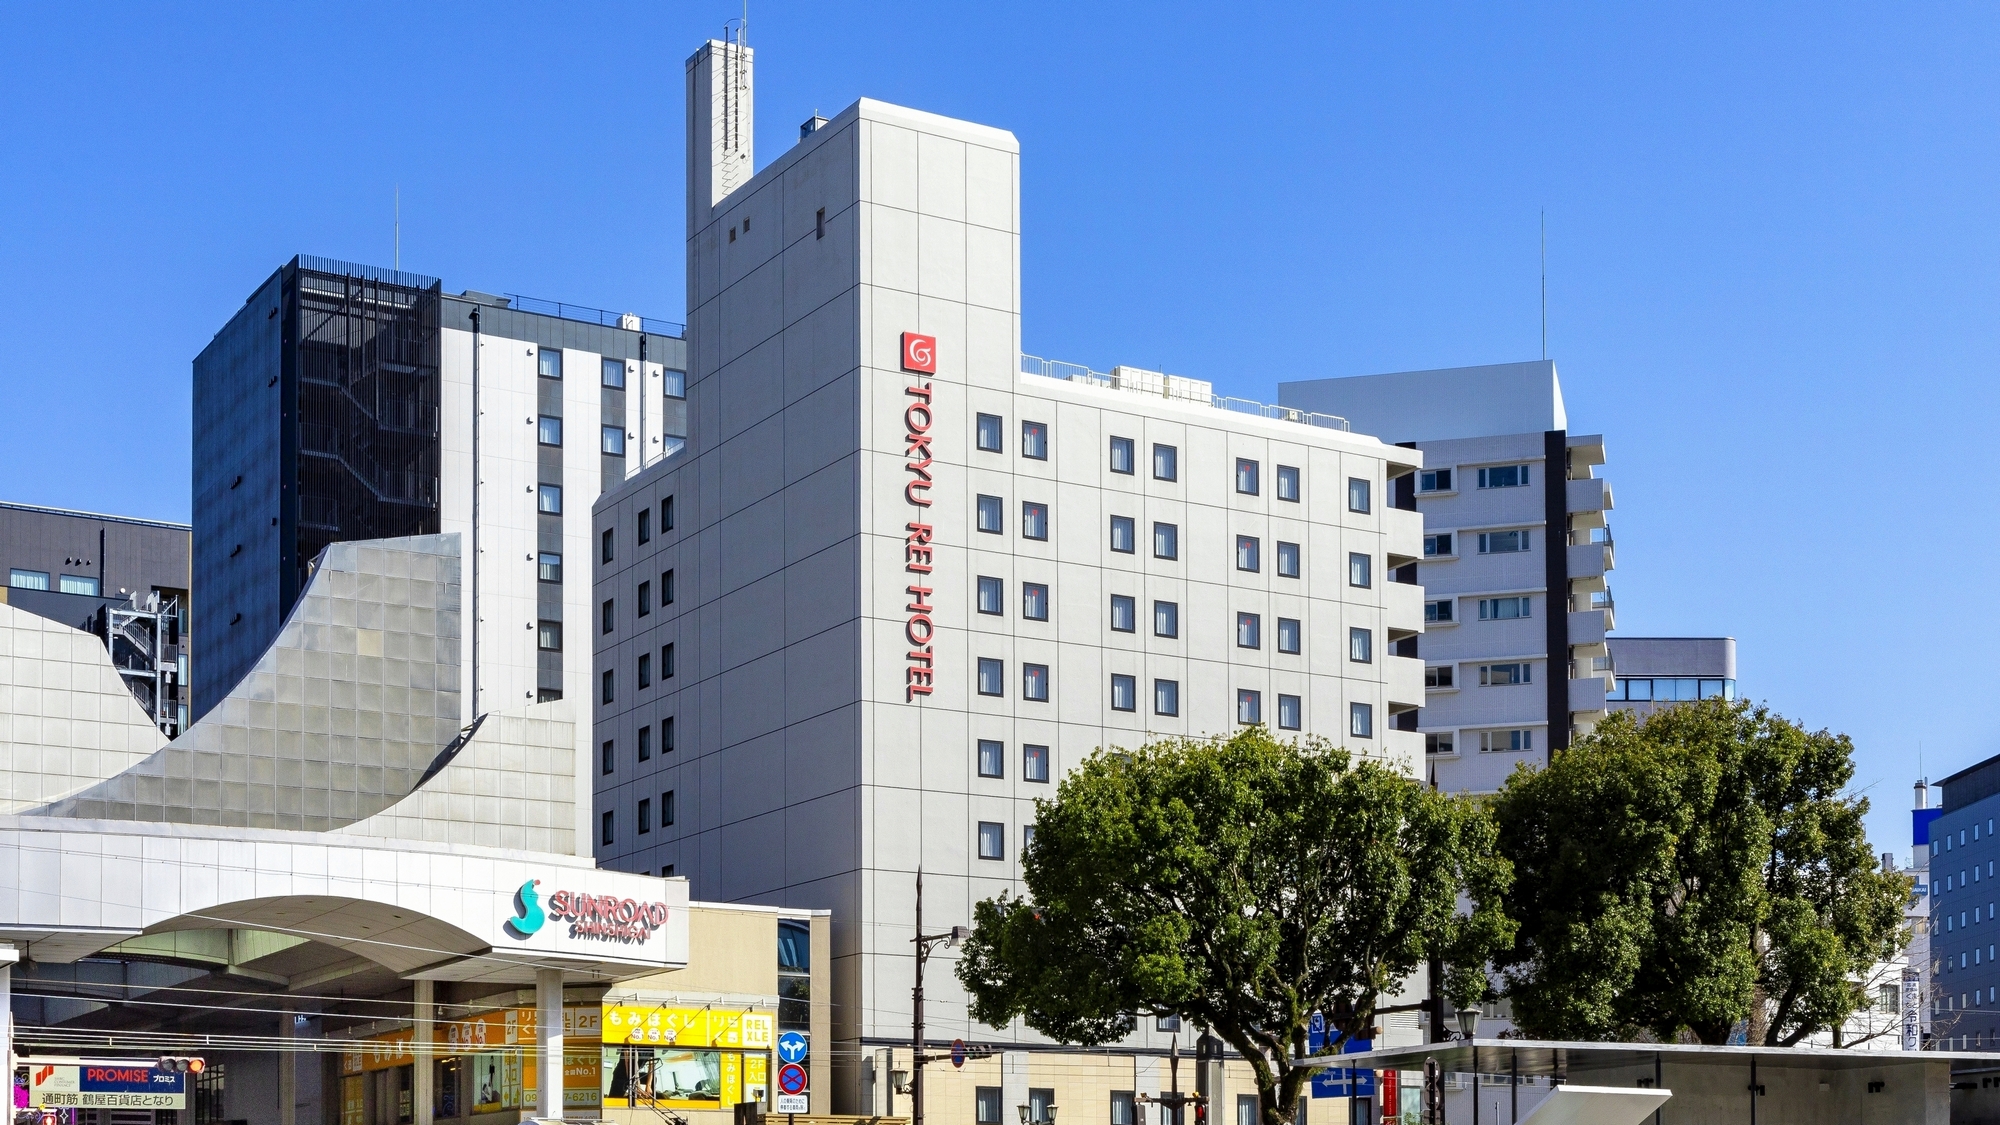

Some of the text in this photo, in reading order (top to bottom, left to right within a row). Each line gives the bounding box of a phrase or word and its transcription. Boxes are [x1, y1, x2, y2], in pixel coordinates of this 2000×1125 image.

[908, 382, 934, 700] TOKYU REI HOTEL
[554, 890, 669, 925] SUNROAD
[575, 920, 651, 940] SHINSHIGAI
[578, 1015, 598, 1028] 2F
[609, 1010, 696, 1029] もみほぐし
[746, 1019, 769, 1030] REL
[746, 1031, 769, 1042] XLE
[87, 1068, 149, 1083] PROMISE
[153, 1075, 176, 1083] プロミス
[42, 1092, 174, 1107] 通町筋 鶴屋百貨店となり
